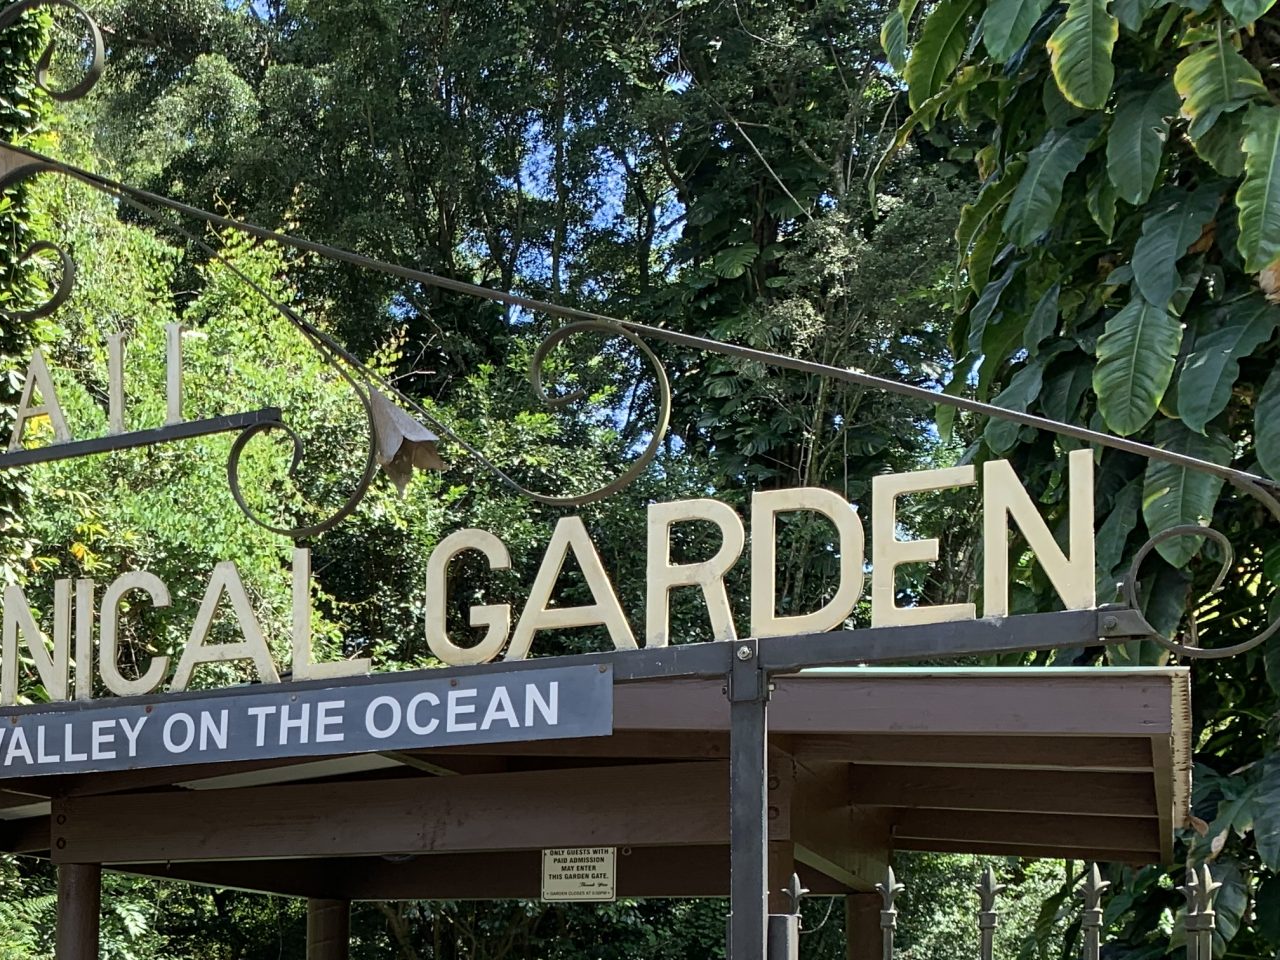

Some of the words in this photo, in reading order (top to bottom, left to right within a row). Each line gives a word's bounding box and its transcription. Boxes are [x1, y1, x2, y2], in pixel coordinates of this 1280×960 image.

[424, 448, 1097, 665] GARDEN
[162, 708, 229, 755] ON
[247, 700, 346, 746] THE
[365, 681, 560, 740] OCEAN
